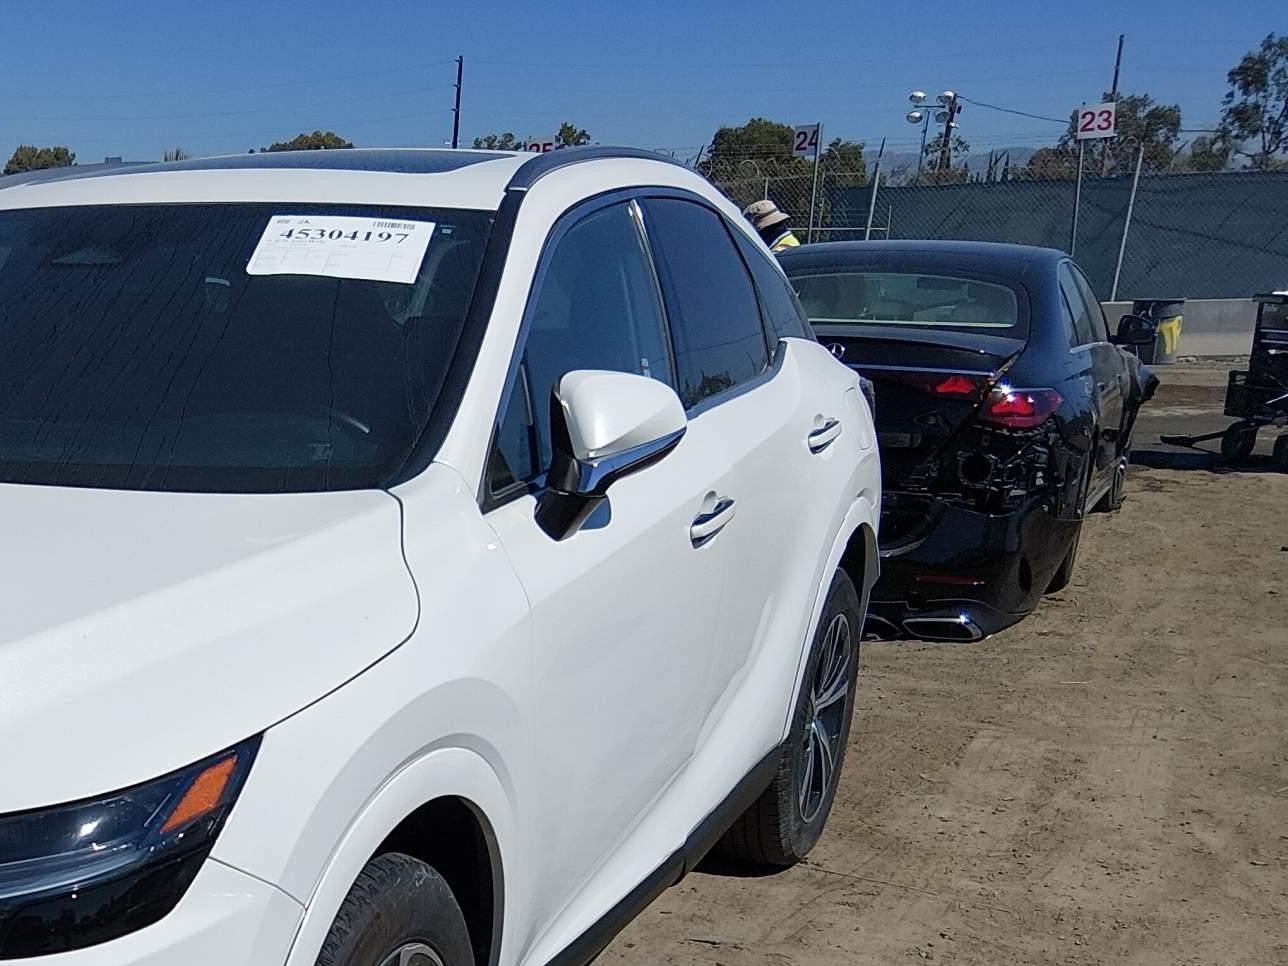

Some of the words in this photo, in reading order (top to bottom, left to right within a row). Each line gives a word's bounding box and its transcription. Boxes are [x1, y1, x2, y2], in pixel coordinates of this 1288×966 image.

[1080, 110, 1114, 132] 23
[795, 132, 819, 152] 24
[279, 227, 411, 245] 45304197
